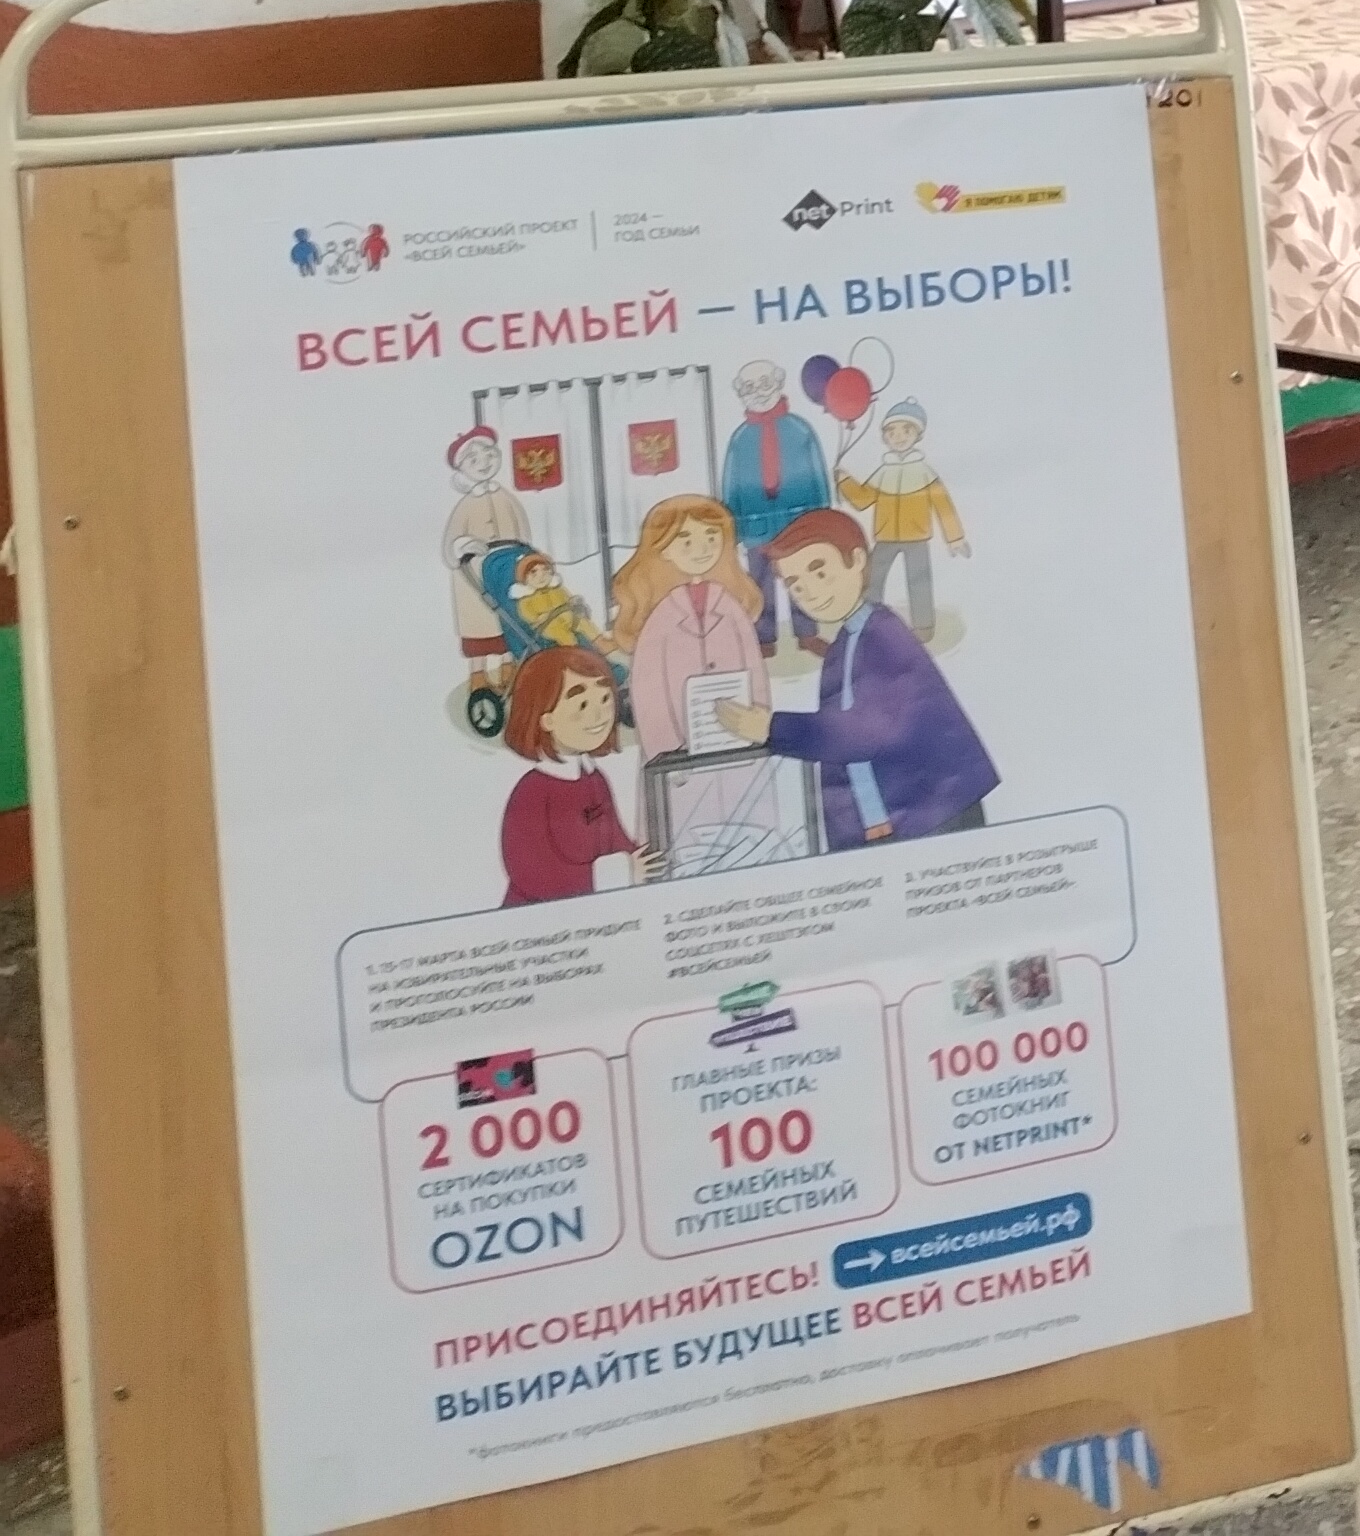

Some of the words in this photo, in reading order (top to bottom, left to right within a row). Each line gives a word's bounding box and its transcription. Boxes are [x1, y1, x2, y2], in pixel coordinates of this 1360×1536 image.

[403, 223, 515, 245] РОССИЙСКИЙ
[519, 219, 578, 234] ПРОЕКТ
[613, 214, 648, 227] 2024
[614, 229, 646, 242] ГОД
[648, 225, 700, 240] СЕМЬИ
[298, 312, 440, 371] ВСЕЙ
[461, 289, 678, 353] СЕМЬЕЙ
[755, 283, 827, 324] НА
[845, 258, 1070, 315] ВЫБОРЫ!
[672, 1059, 766, 1092] ГЛАВНЫЕ
[771, 1047, 840, 1072] ПРИЗЫ
[930, 1040, 999, 1080] 100
[1013, 1021, 1088, 1063] 000
[700, 1076, 816, 1113] ПРОЕКТА:
[952, 1069, 1067, 1107] СЕМЕЙНЫХ
[953, 1091, 1070, 1130] ФОТОКНИГ
[420, 1124, 450, 1171] 2
[470, 1101, 581, 1158] 000
[710, 1110, 812, 1168] 100
[934, 1142, 966, 1164] ОТ
[417, 1153, 588, 1199] СЕРТИФИКАТОВ
[694, 1160, 835, 1205] СЕМЕЙНЫХ
[434, 1201, 465, 1220] НА
[470, 1179, 576, 1212] ПОКУПКИ
[675, 1179, 857, 1236] ПУТЕШЕСТВИЙ
[432, 1206, 583, 1268] OZON
[890, 1202, 1082, 1265] всейсемьей.рф
[435, 1262, 818, 1368] ПРИСОЕДИНЯЙТЕСЬ!
[435, 1347, 662, 1422] ВЫБИРАЙТЕ
[673, 1308, 842, 1369] БУДУЩЕЕ
[853, 1281, 942, 1329] ВСЕЙ
[955, 1246, 1090, 1306] СЕМЬЕЙ
